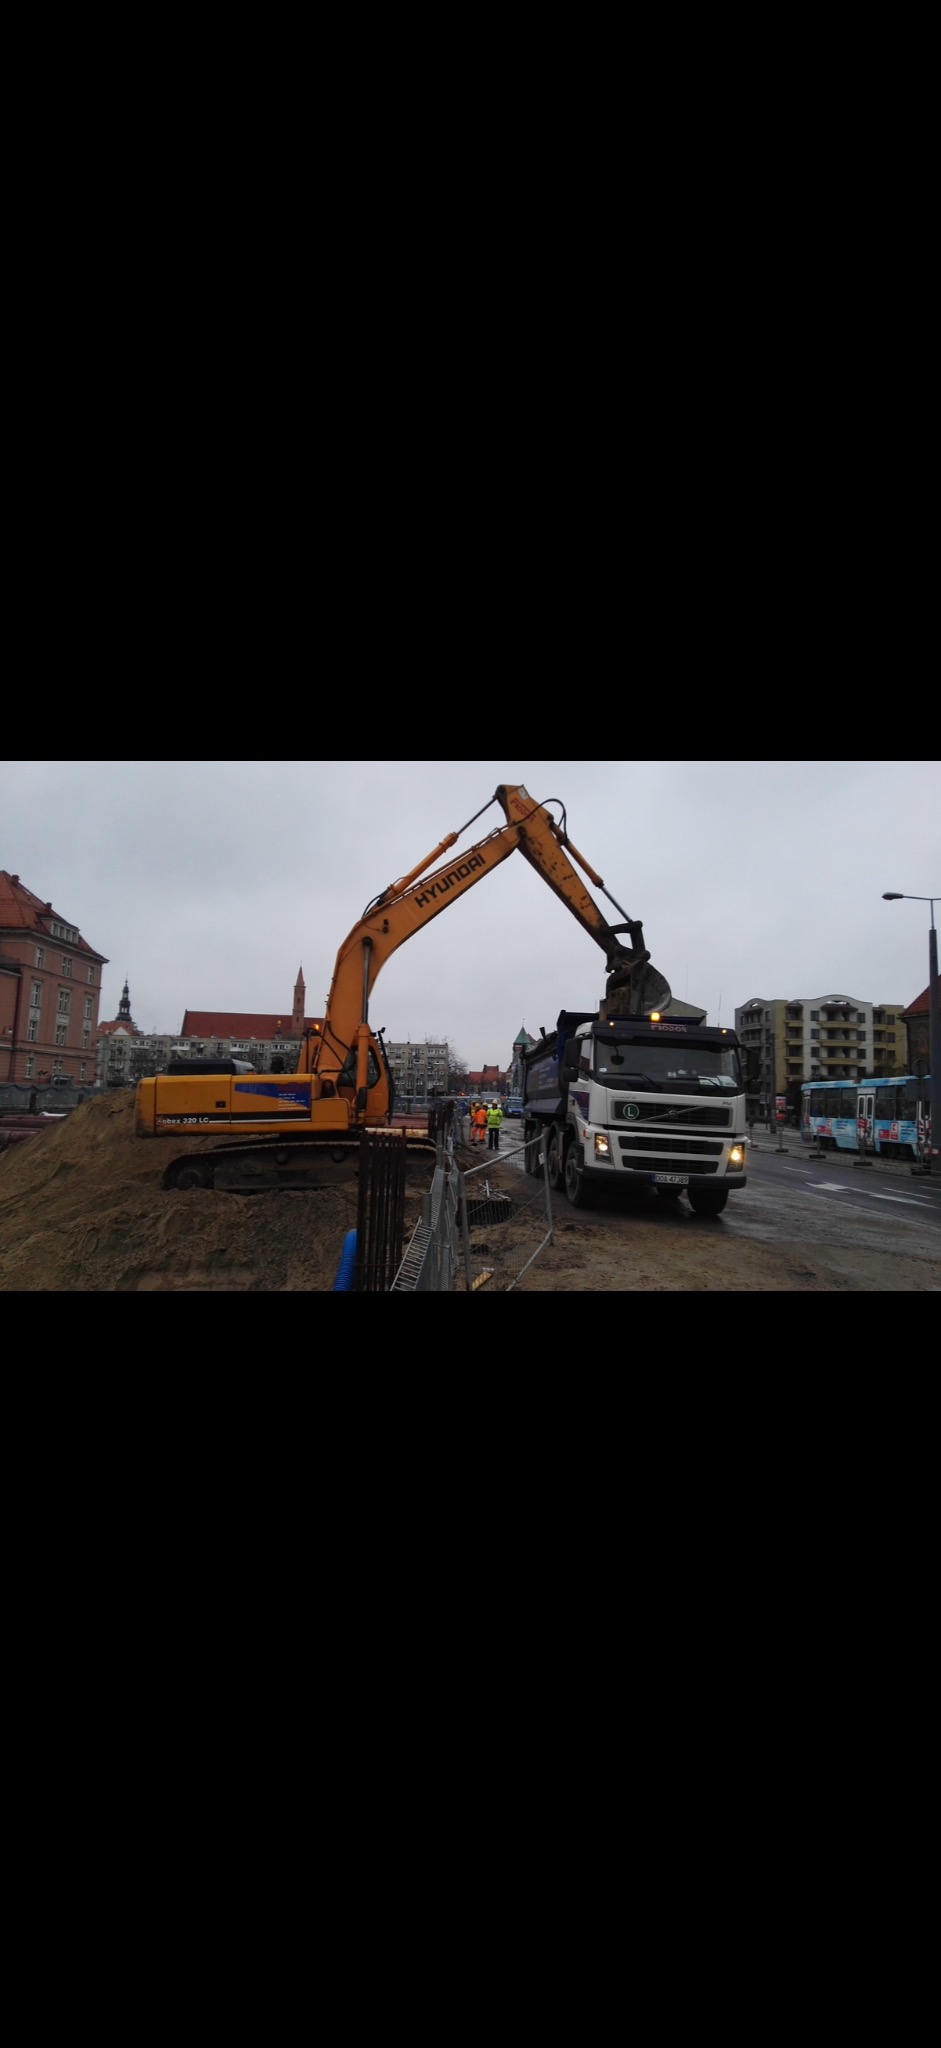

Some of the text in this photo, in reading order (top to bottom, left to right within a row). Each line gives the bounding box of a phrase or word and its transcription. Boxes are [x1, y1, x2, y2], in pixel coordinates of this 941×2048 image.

[414, 853, 486, 908] HYUNDAI
[627, 1106, 635, 1117] L
[669, 1176, 688, 1184] 47389
